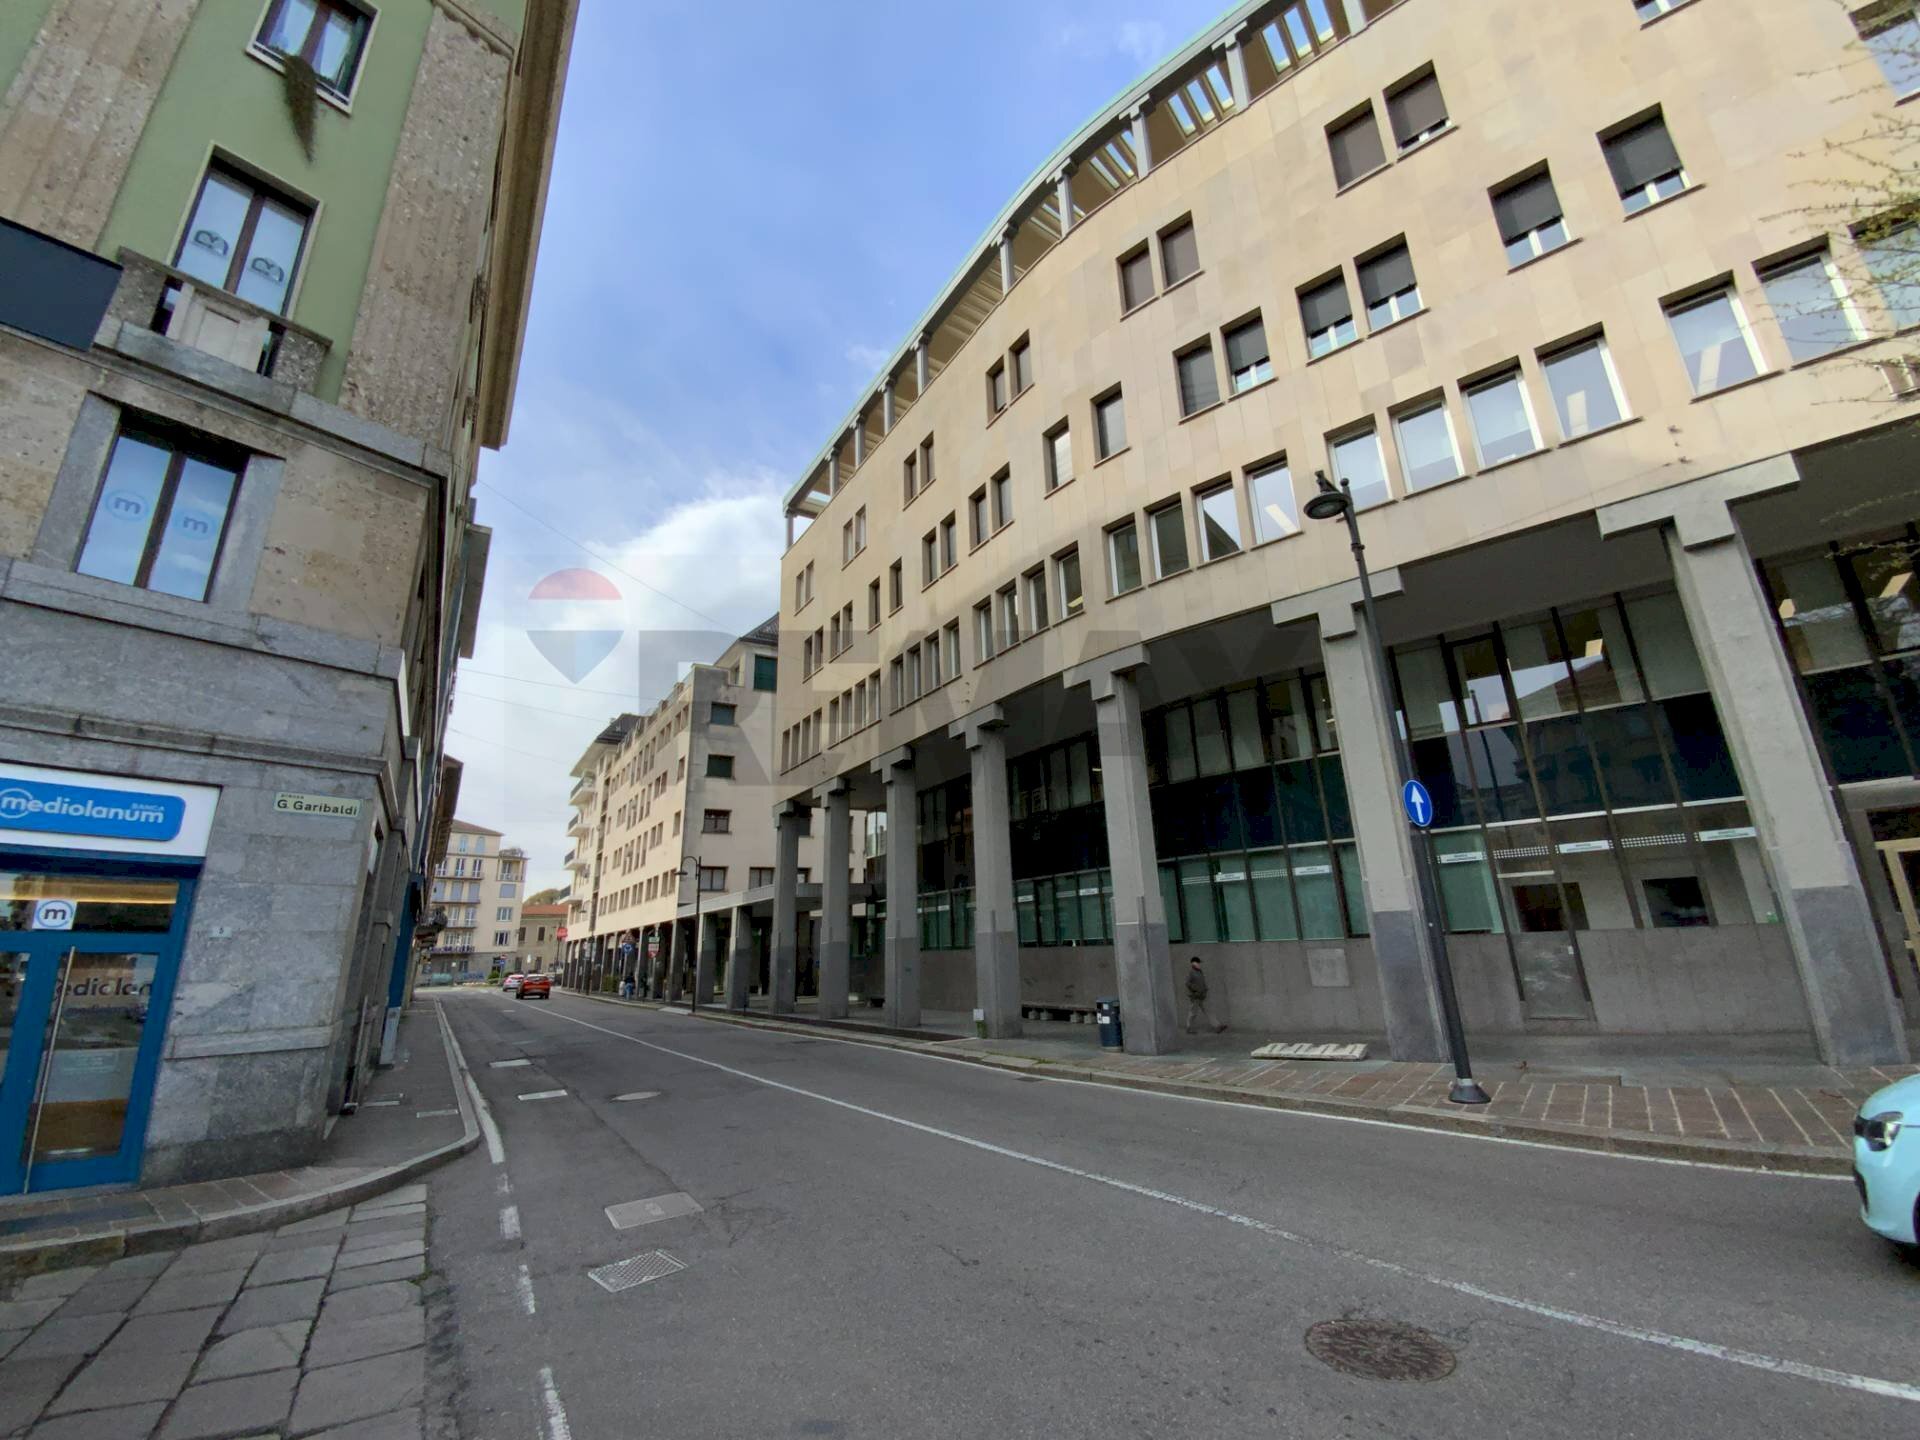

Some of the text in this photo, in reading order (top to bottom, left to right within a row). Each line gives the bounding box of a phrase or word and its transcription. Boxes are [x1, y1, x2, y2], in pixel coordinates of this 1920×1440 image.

[0, 796, 164, 823] mediolanum
[293, 800, 357, 816] Garibaldi
[44, 907, 67, 921] m
